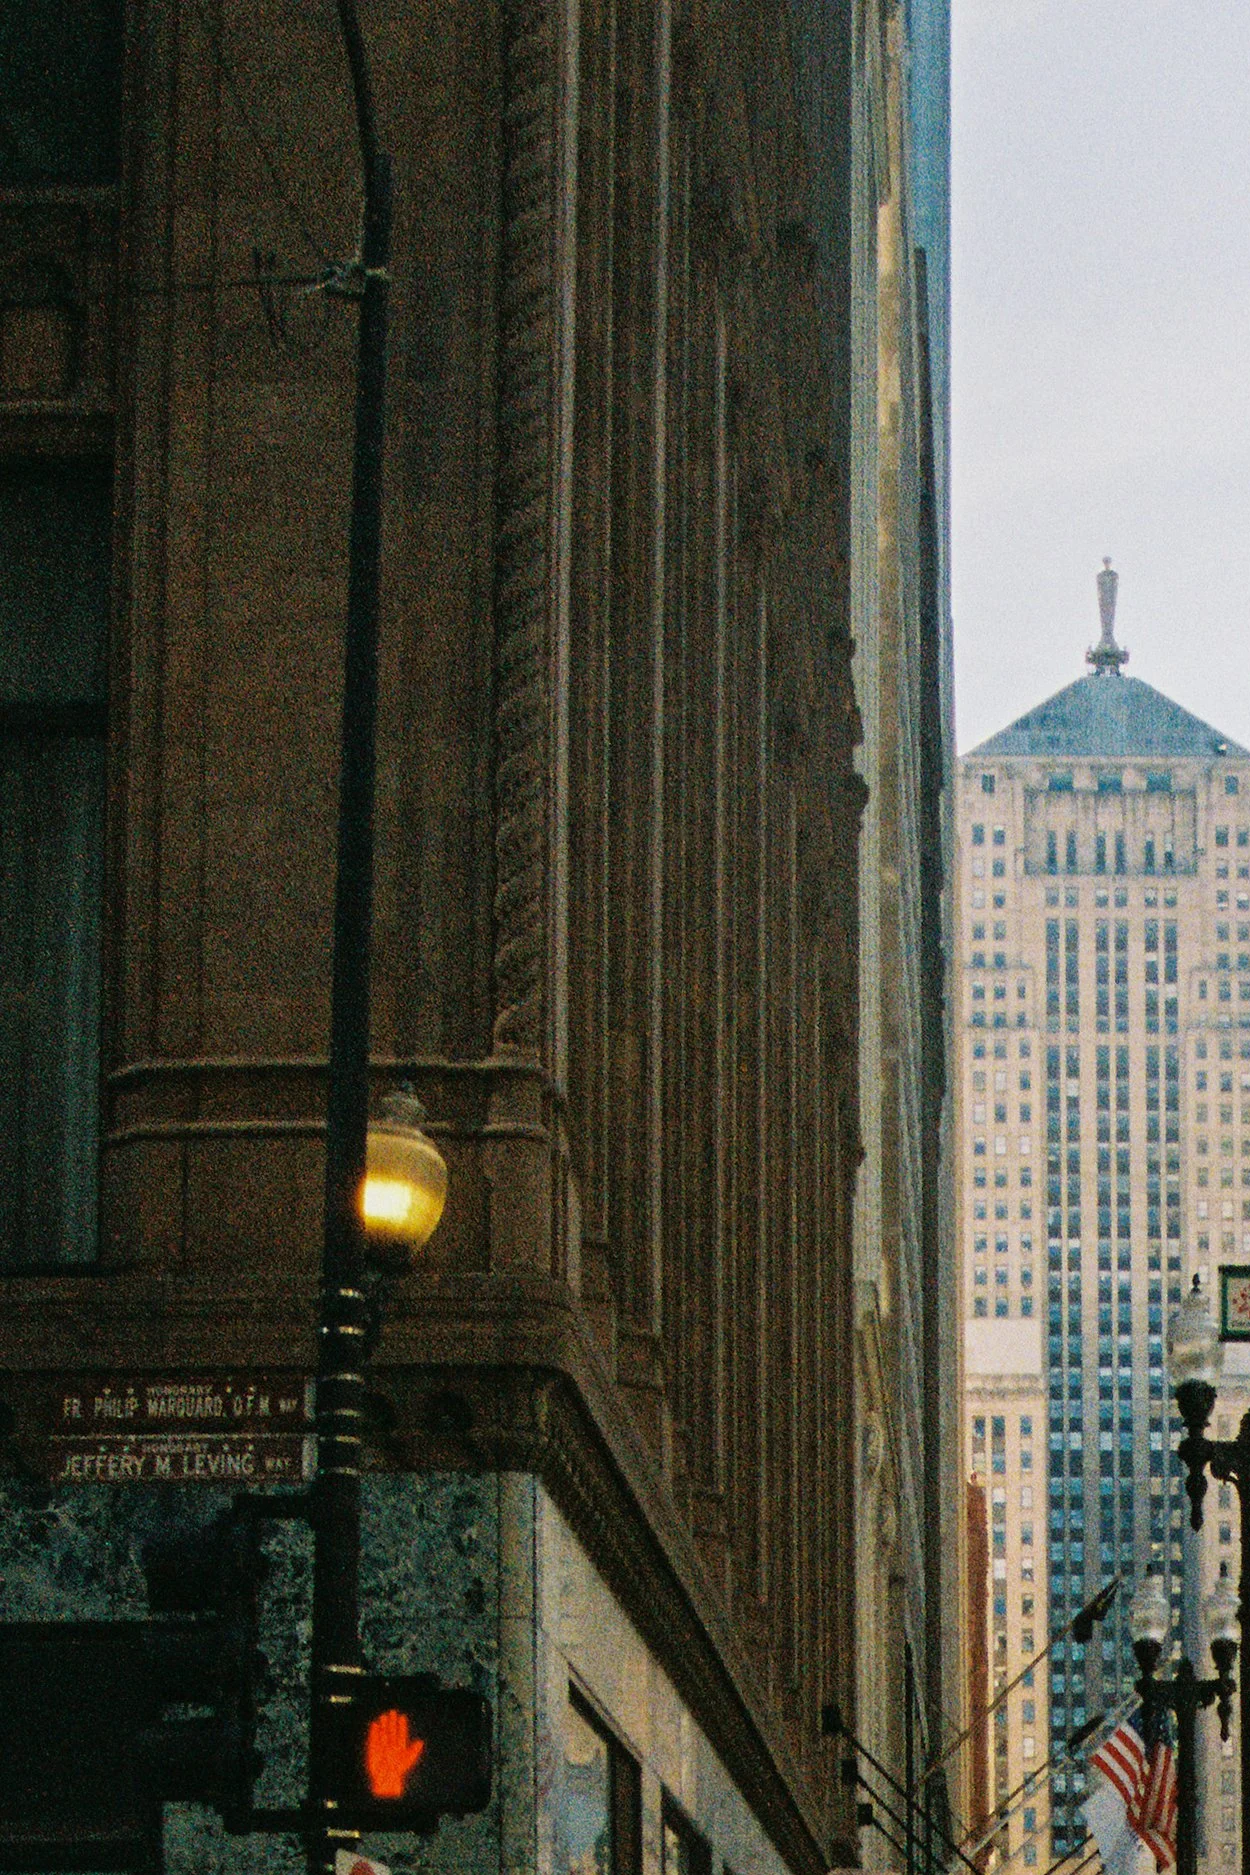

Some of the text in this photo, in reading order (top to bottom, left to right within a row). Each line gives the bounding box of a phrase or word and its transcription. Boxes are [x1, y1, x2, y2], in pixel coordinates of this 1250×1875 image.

[94, 1396, 139, 1419] PHILIP
[60, 1454, 147, 1478] JEFFERY
[182, 1453, 256, 1476] LEVING
